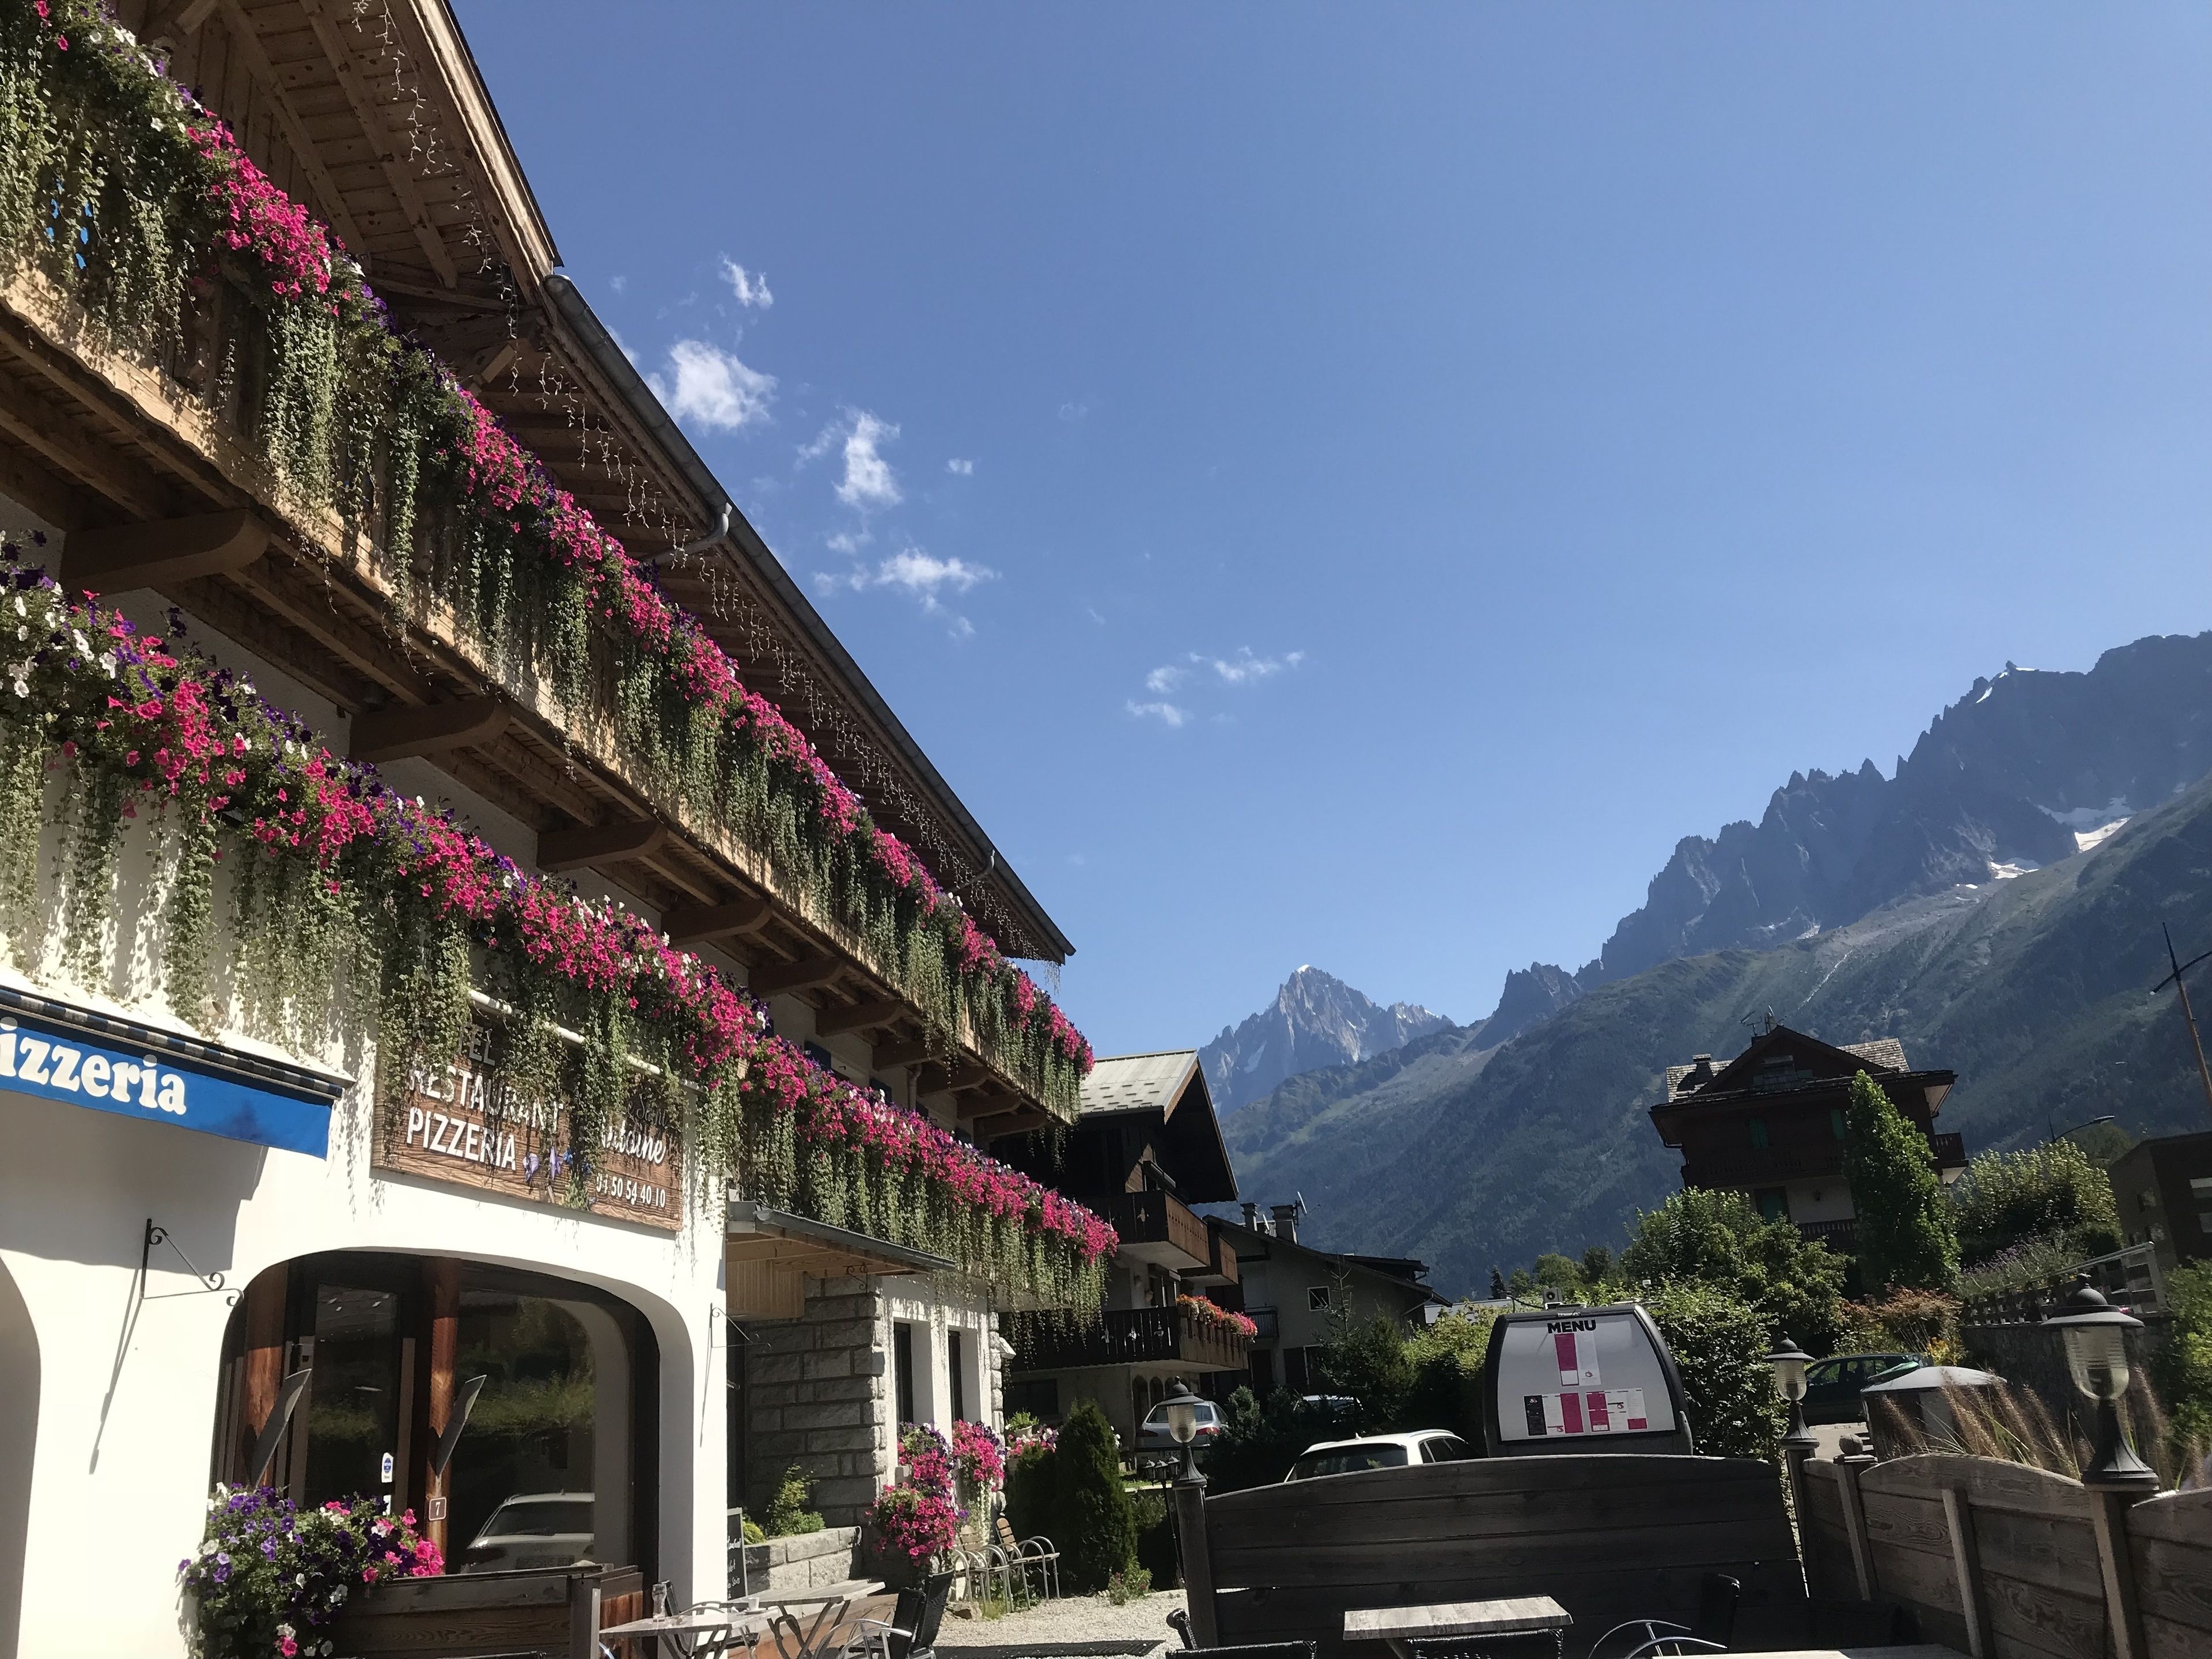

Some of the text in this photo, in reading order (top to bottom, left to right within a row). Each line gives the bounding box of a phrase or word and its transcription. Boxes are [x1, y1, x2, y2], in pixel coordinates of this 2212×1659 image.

[407, 1107, 516, 1171] PIZZERIA
[596, 1173, 666, 1208] 04 50 54 40 10
[1547, 1319, 1597, 1334] MENU
[435, 1501, 441, 1516] 7
